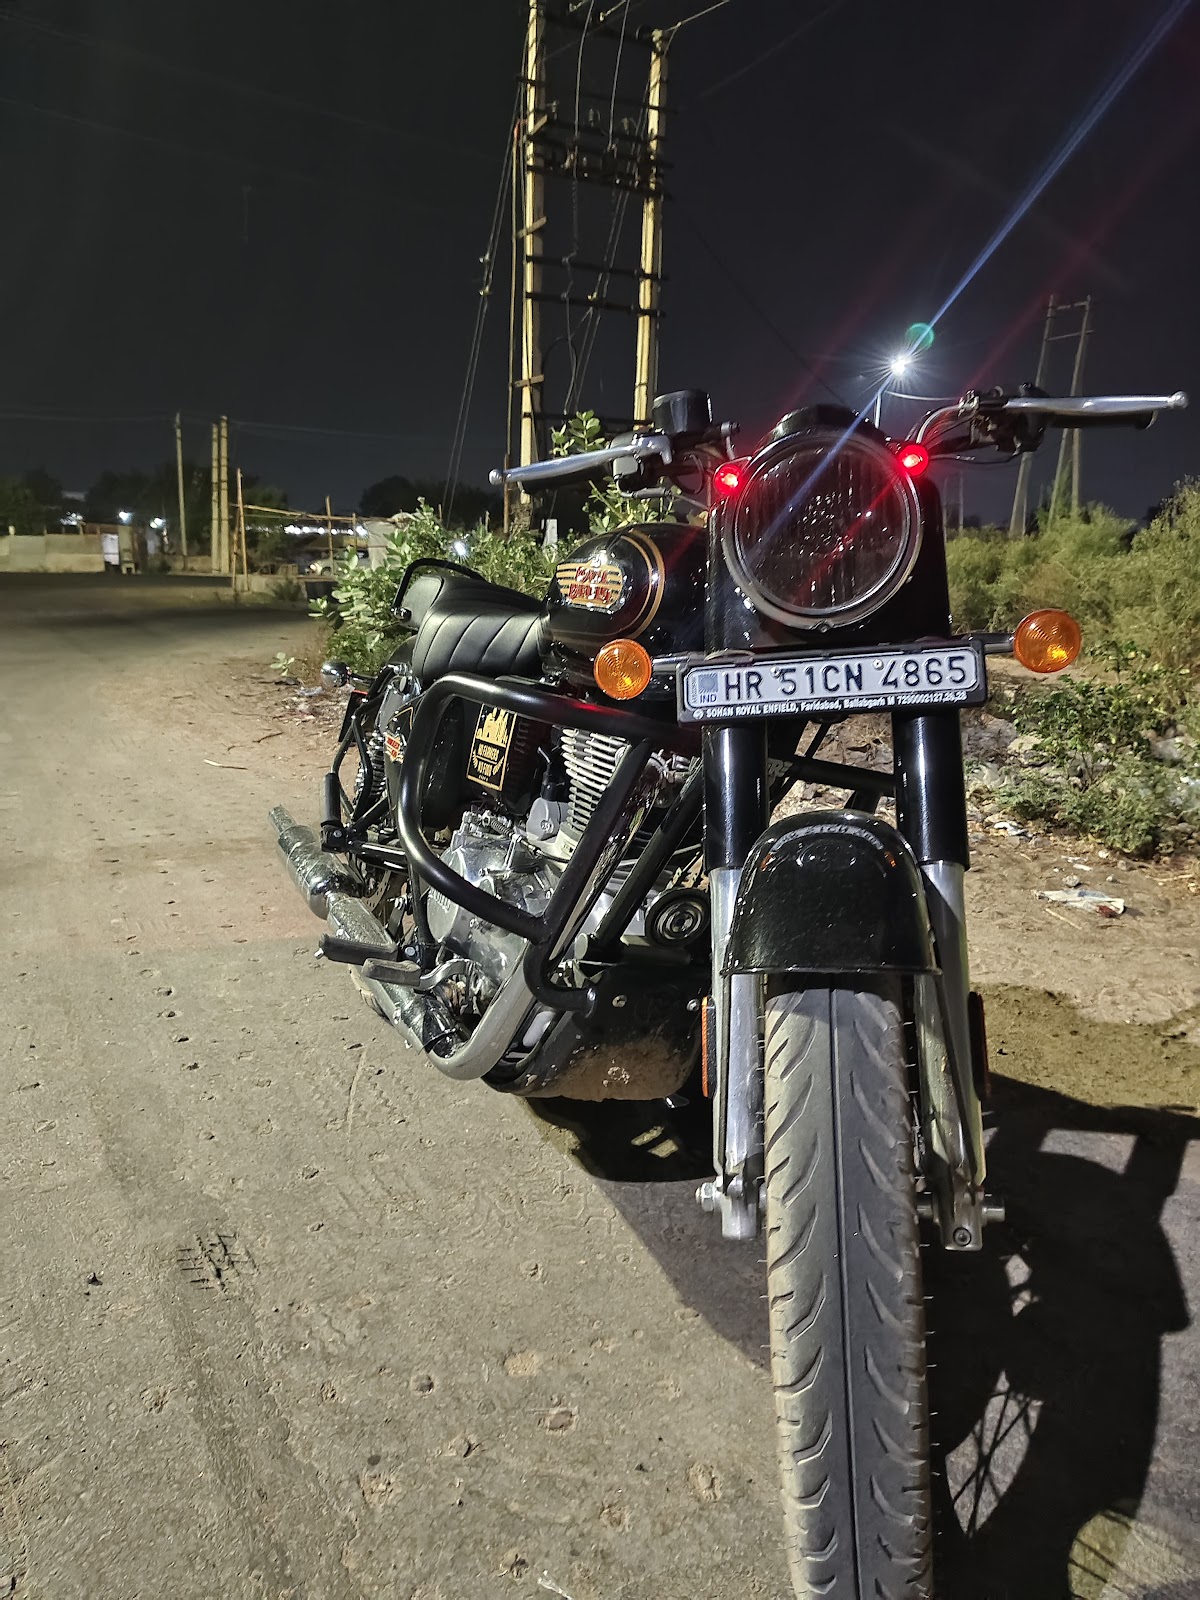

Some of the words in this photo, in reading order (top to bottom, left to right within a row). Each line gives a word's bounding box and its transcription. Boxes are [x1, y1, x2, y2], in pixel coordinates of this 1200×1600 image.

[724, 671, 762, 700] HR
[779, 664, 862, 695] 51CN
[881, 656, 965, 688] 4865
[699, 694, 717, 703] IND
[736, 704, 761, 716] ROYAL
